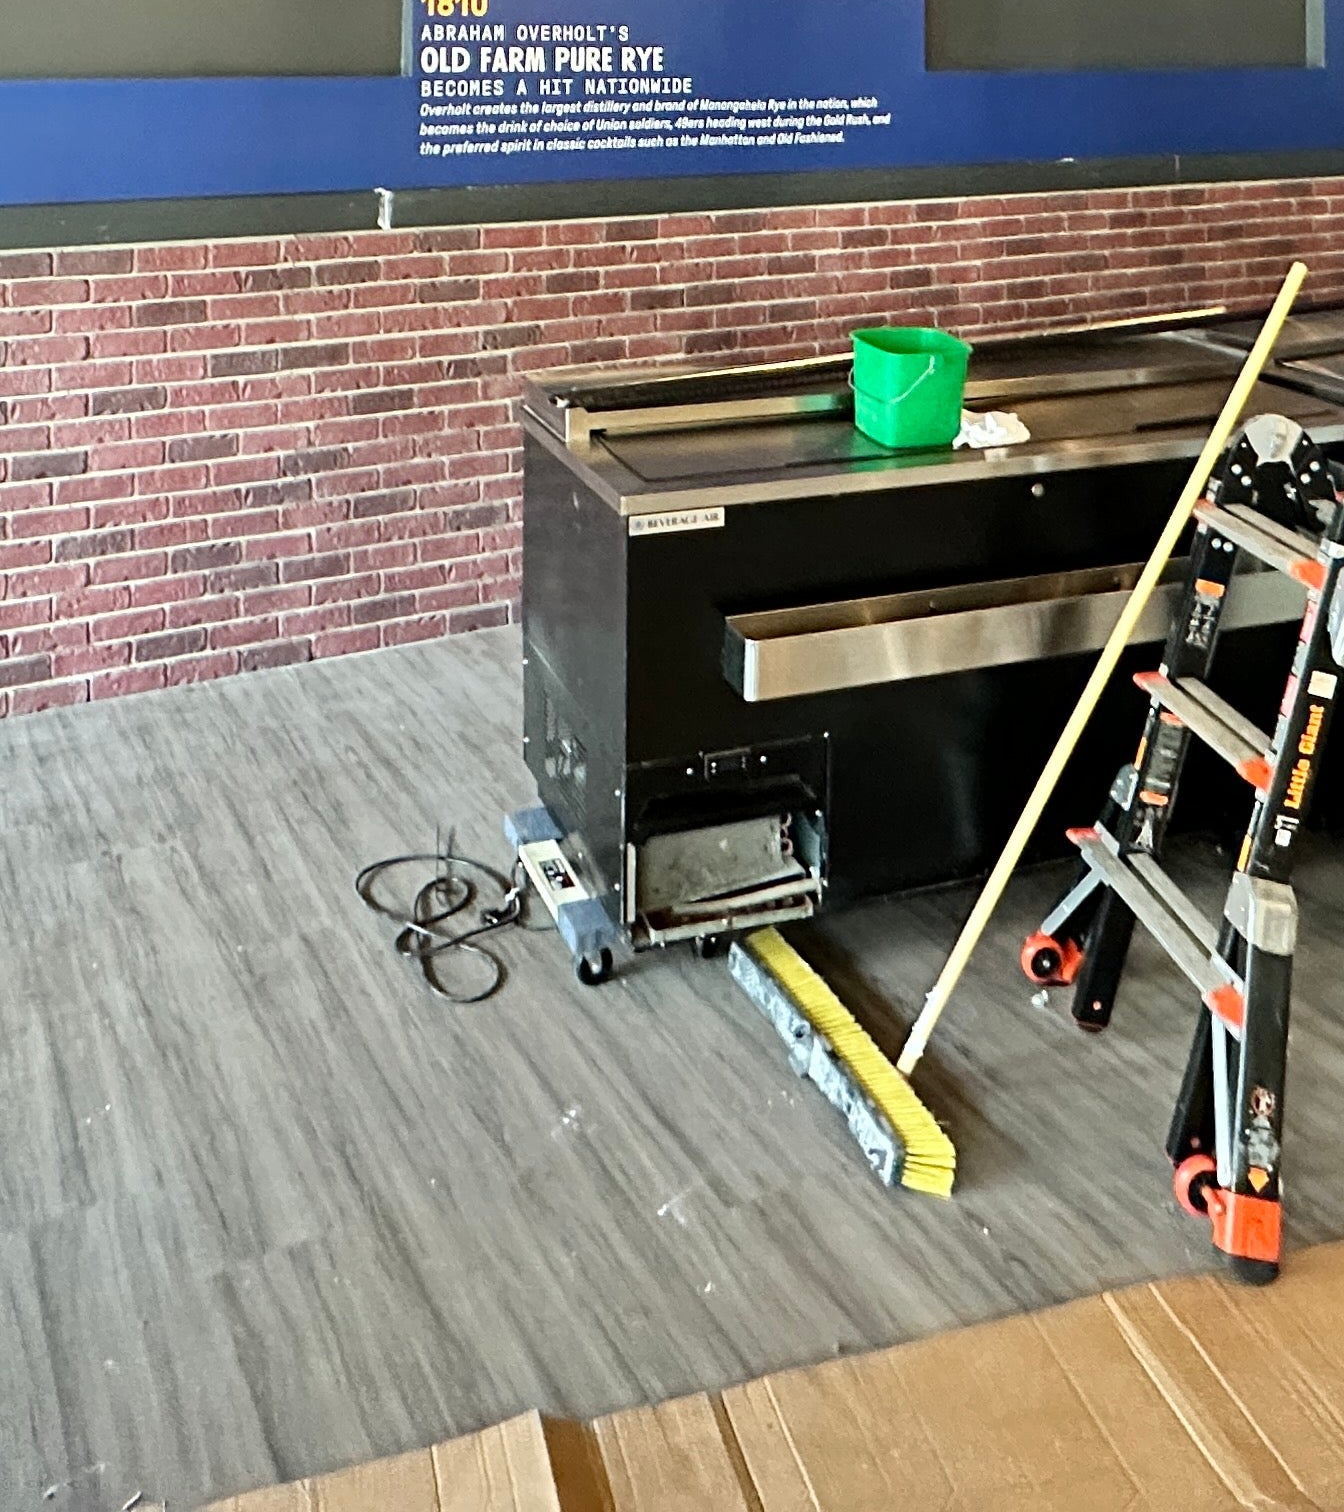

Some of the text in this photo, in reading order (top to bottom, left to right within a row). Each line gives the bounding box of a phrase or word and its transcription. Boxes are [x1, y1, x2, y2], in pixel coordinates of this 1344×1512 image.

[420, 23, 628, 42] ABRAHAM OVERHOLT'S
[420, 46, 664, 73] OLD FARM PURE RYE
[420, 77, 692, 97] BECOMES A HIT NATIONWIDE
[1284, 758, 1311, 809] Little
